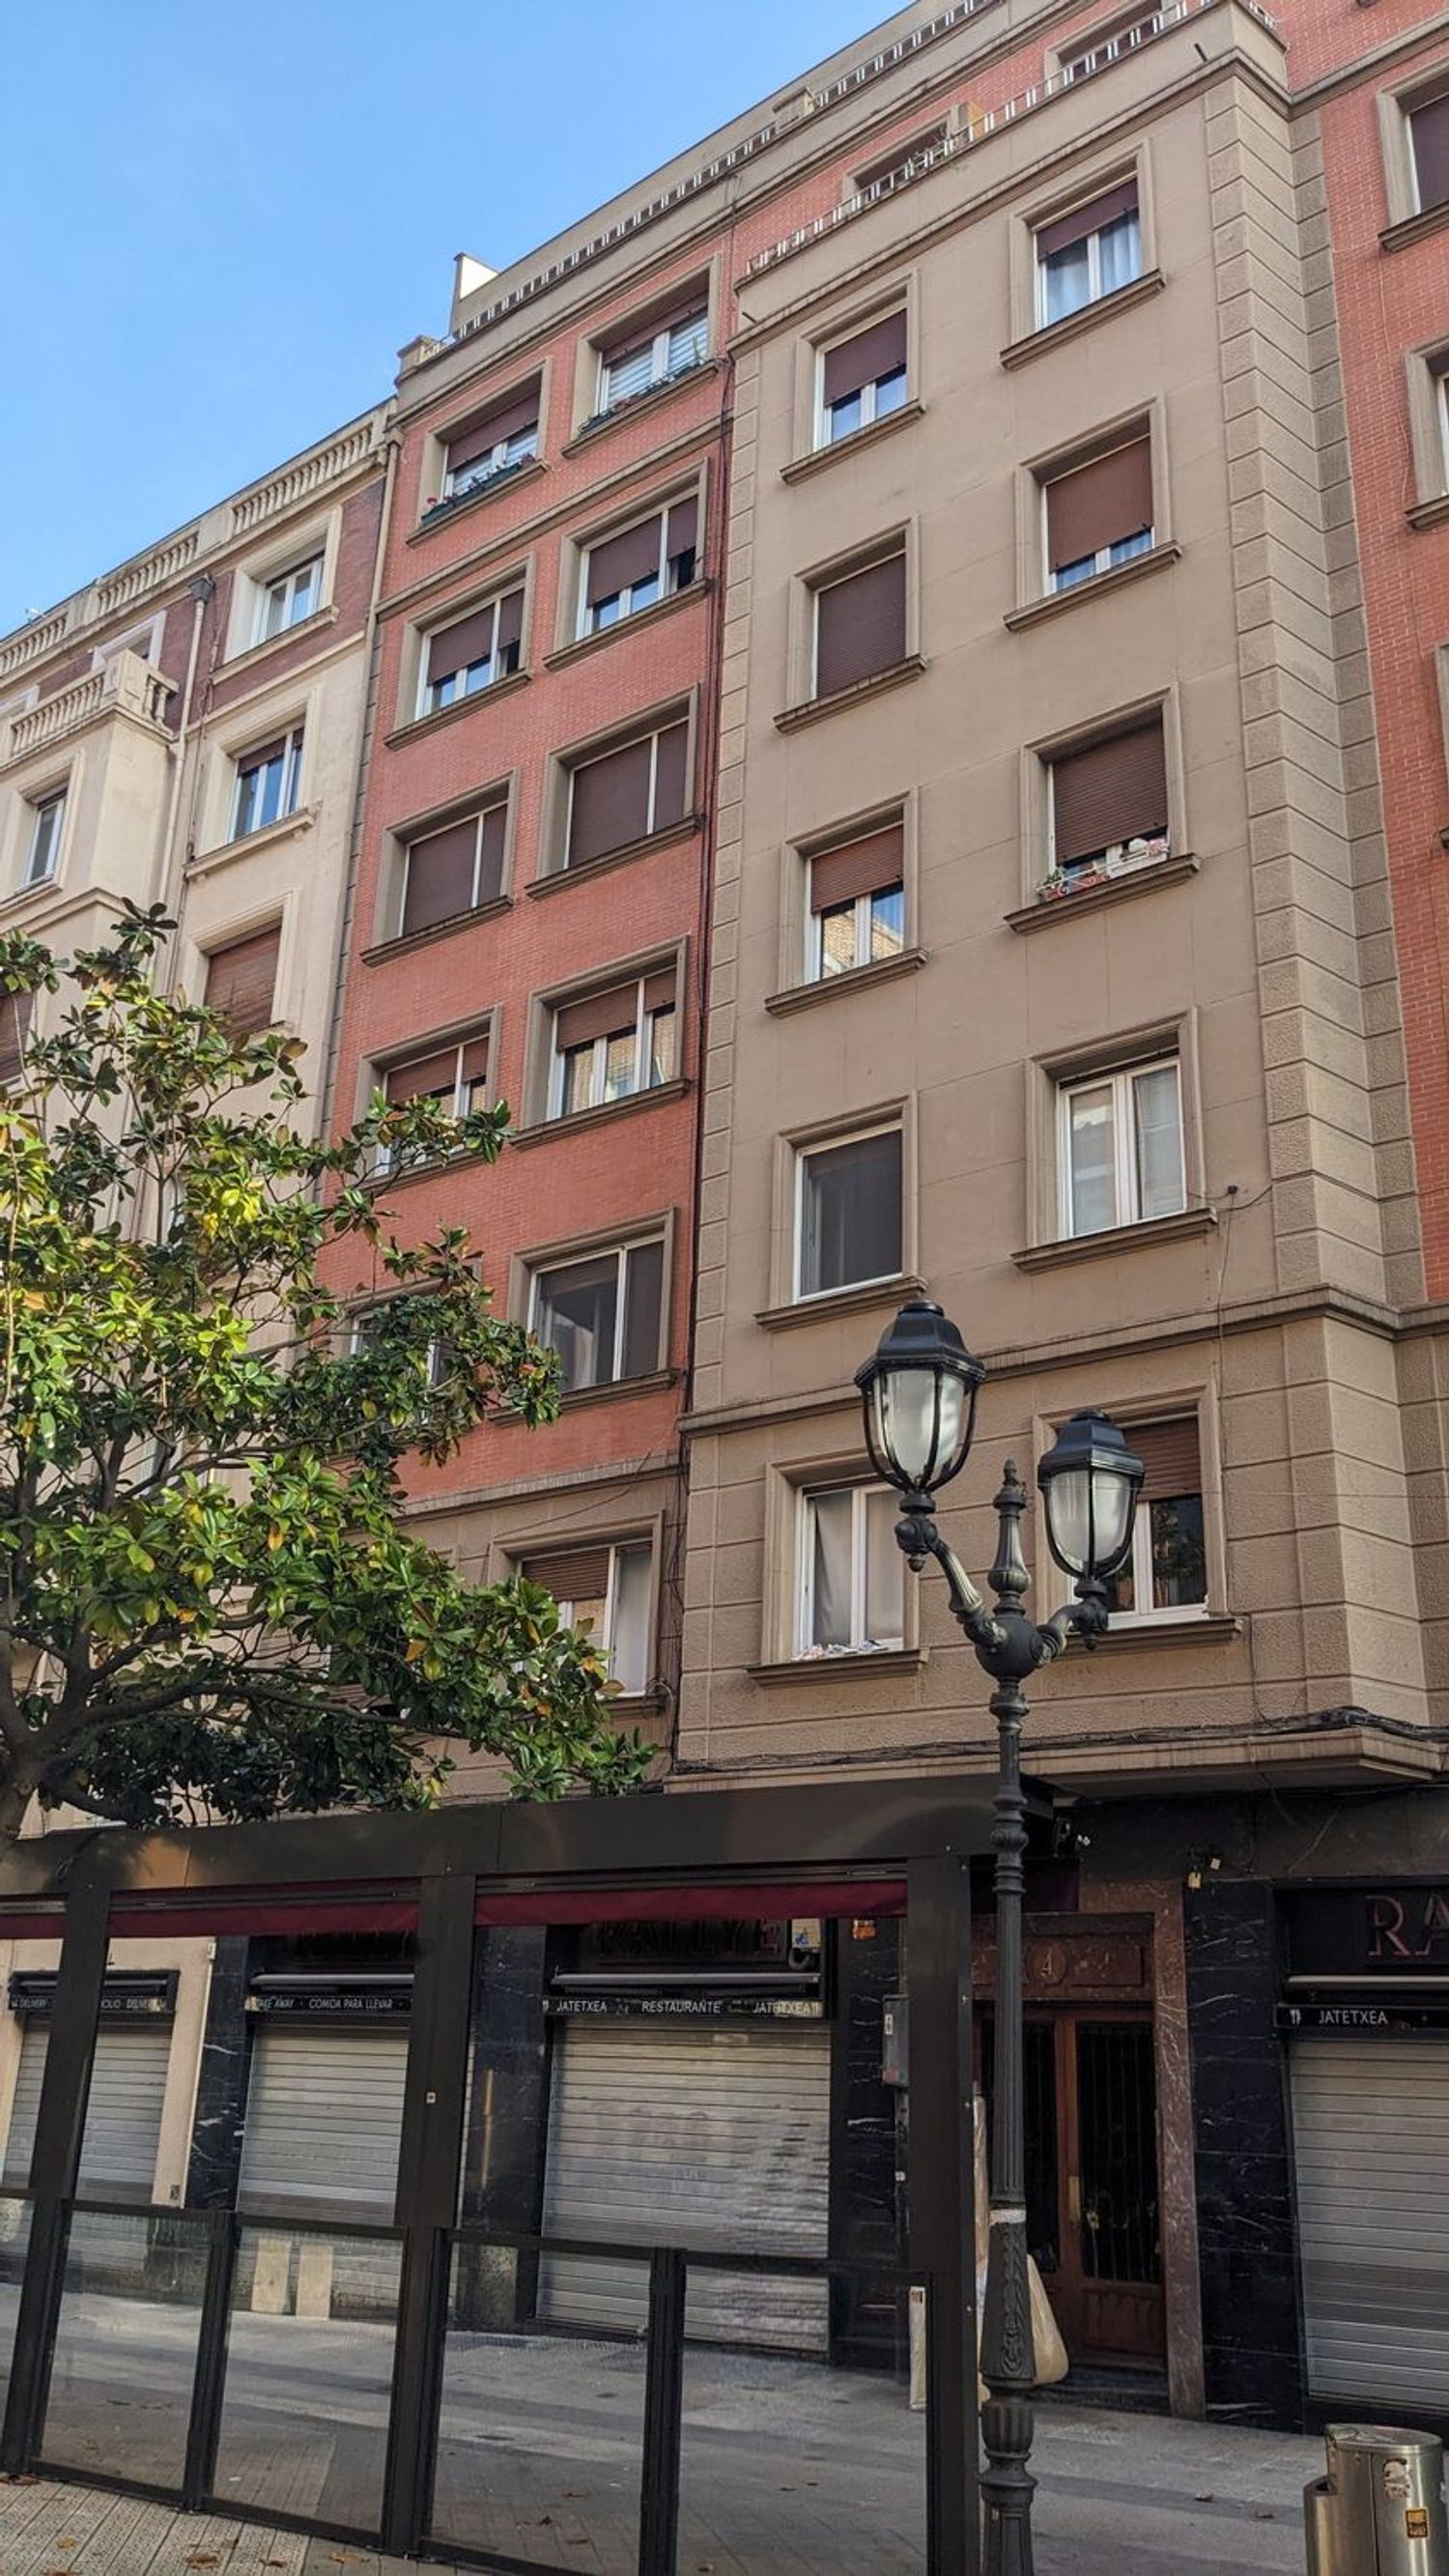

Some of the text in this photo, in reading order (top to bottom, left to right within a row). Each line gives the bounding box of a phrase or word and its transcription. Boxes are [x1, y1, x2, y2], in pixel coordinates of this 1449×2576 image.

[1040, 1949, 1053, 1976] 4
[308, 1998, 341, 2009] COMIDA
[343, 1998, 363, 2009] PARA
[365, 1998, 393, 2009] LLEVAR
[556, 2000, 608, 2013] JATETXEA
[641, 2000, 722, 2014] RESTAURANTE
[1319, 2010, 1389, 2024] JATETXEA
